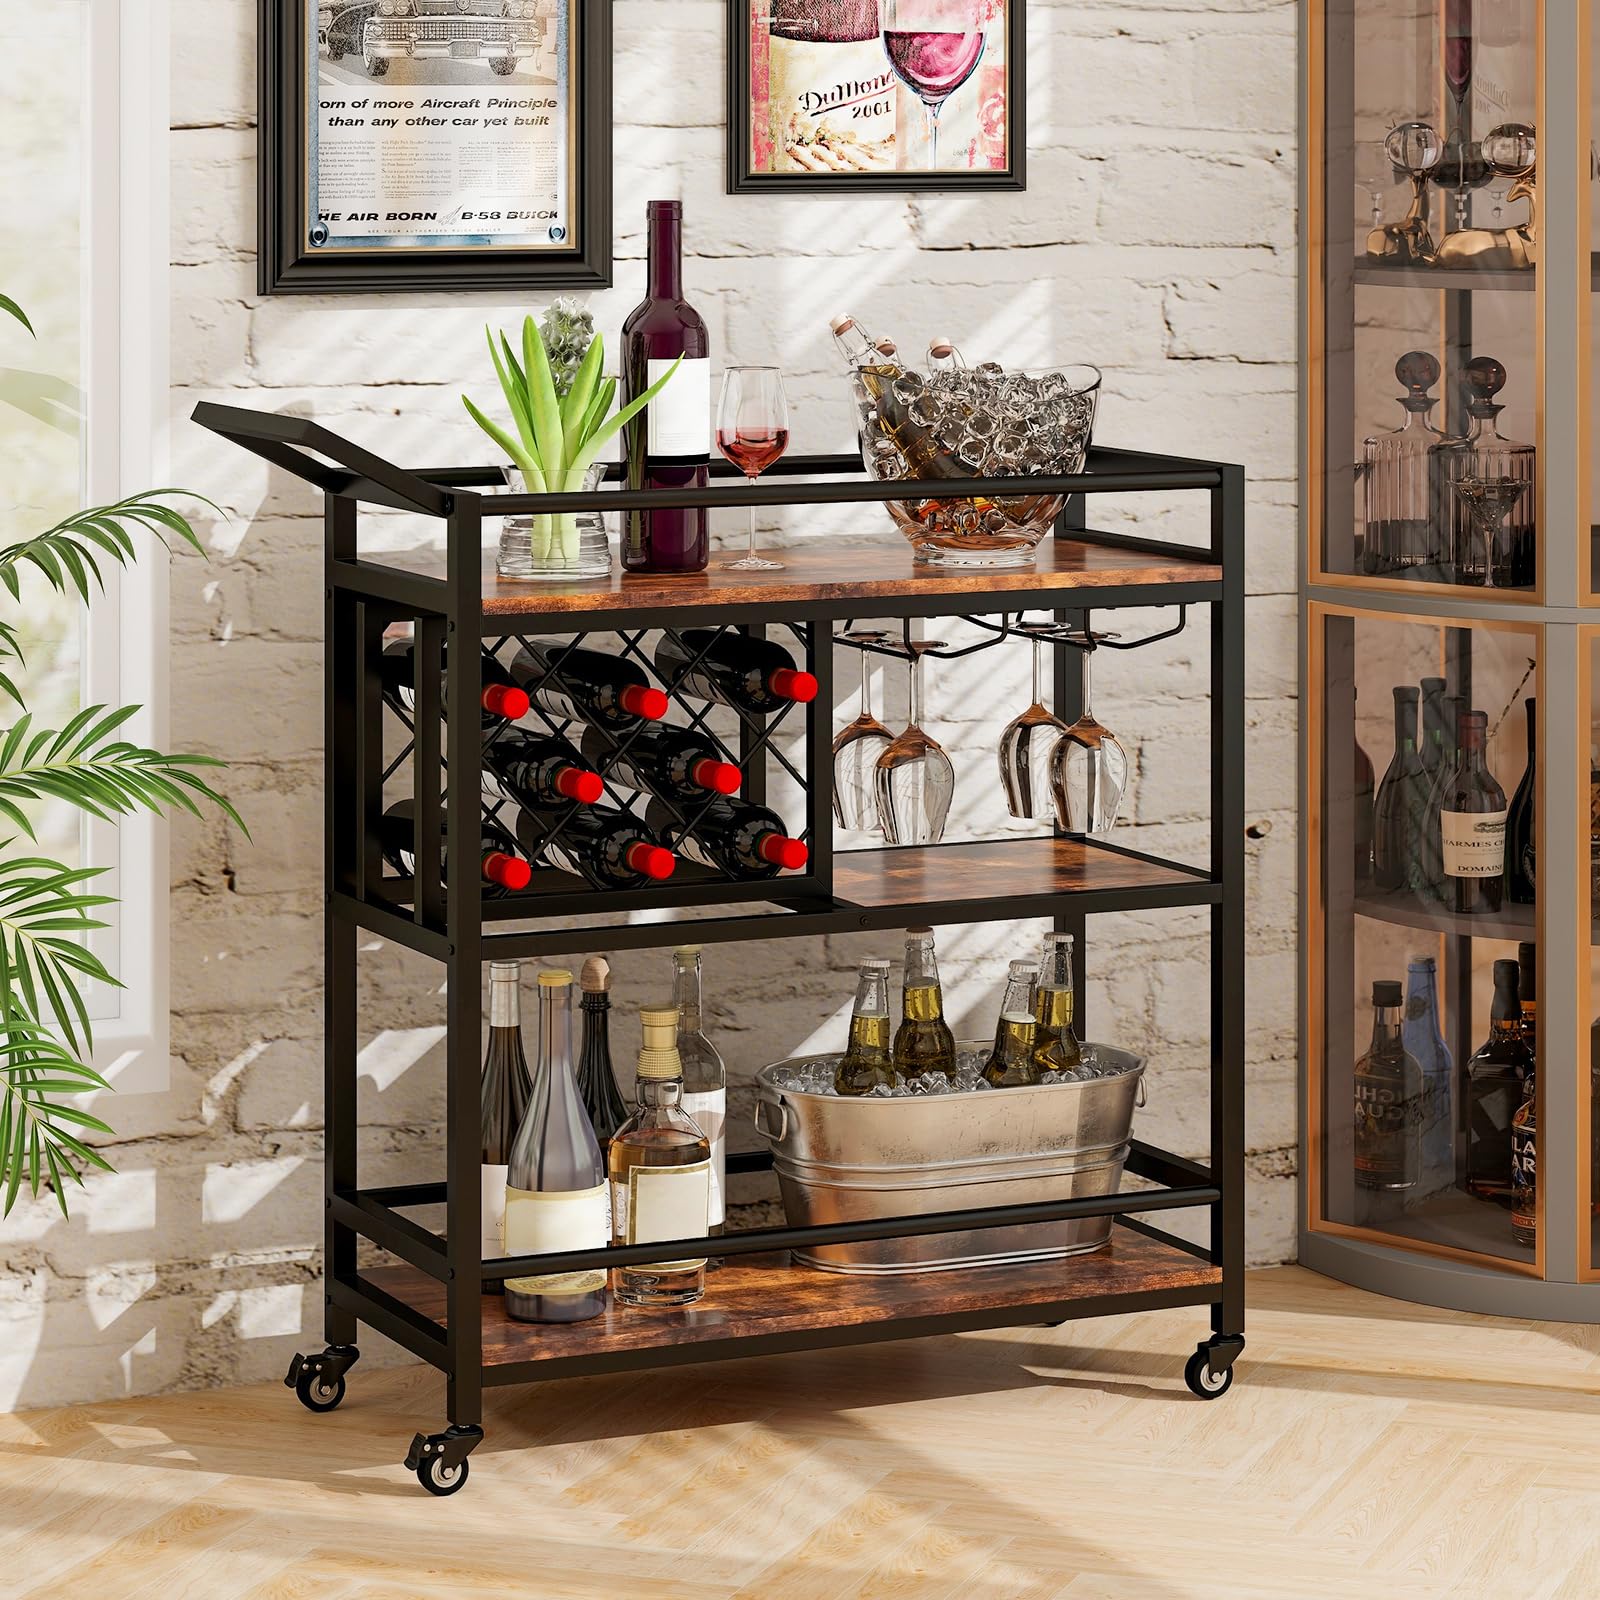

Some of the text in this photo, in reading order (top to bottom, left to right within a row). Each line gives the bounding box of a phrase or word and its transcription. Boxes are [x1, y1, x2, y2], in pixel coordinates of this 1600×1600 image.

[318, 97, 558, 111] orn of more Aircraft Principle
[852, 100, 892, 119] 2001
[328, 115, 550, 128] than any other car yet built
[346, 212, 379, 221] AIR
[385, 212, 437, 221] BORN
[506, 210, 558, 220] BUICK
[1511, 1135, 1537, 1156] LA
